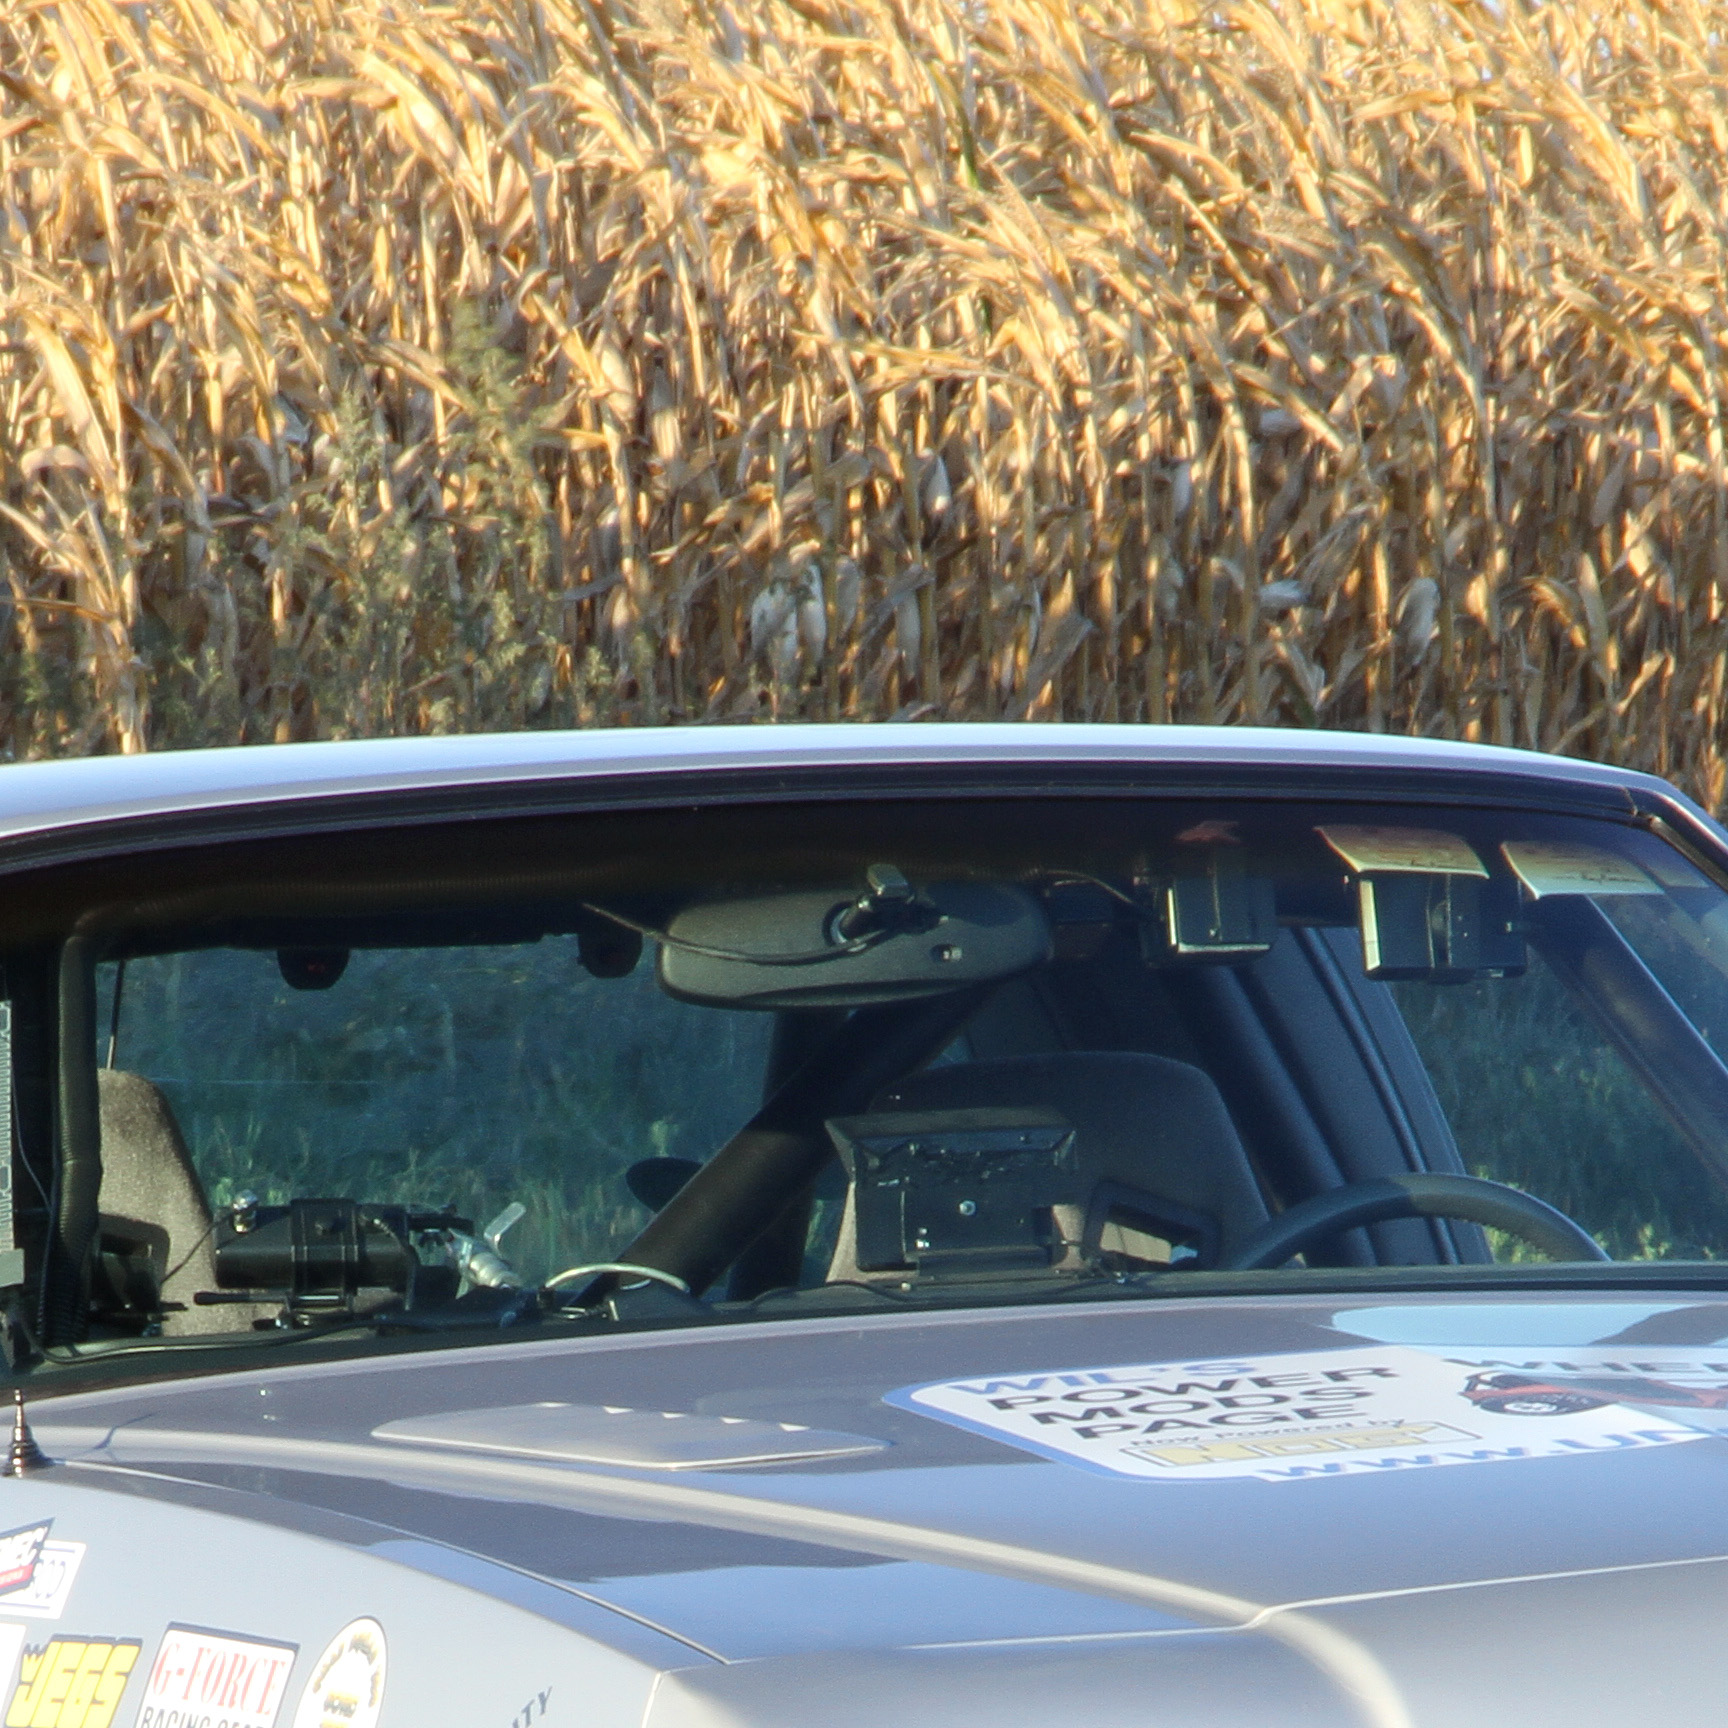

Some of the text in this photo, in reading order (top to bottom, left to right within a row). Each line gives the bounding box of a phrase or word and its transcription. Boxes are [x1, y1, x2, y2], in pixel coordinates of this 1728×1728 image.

[947, 1361, 1259, 1395] WIL'S
[987, 1366, 1402, 1411] POWER
[1029, 1385, 1374, 1425] MODS
[1072, 1403, 1370, 1440] PAGE
[152, 1641, 287, 1716] G-FORCE
